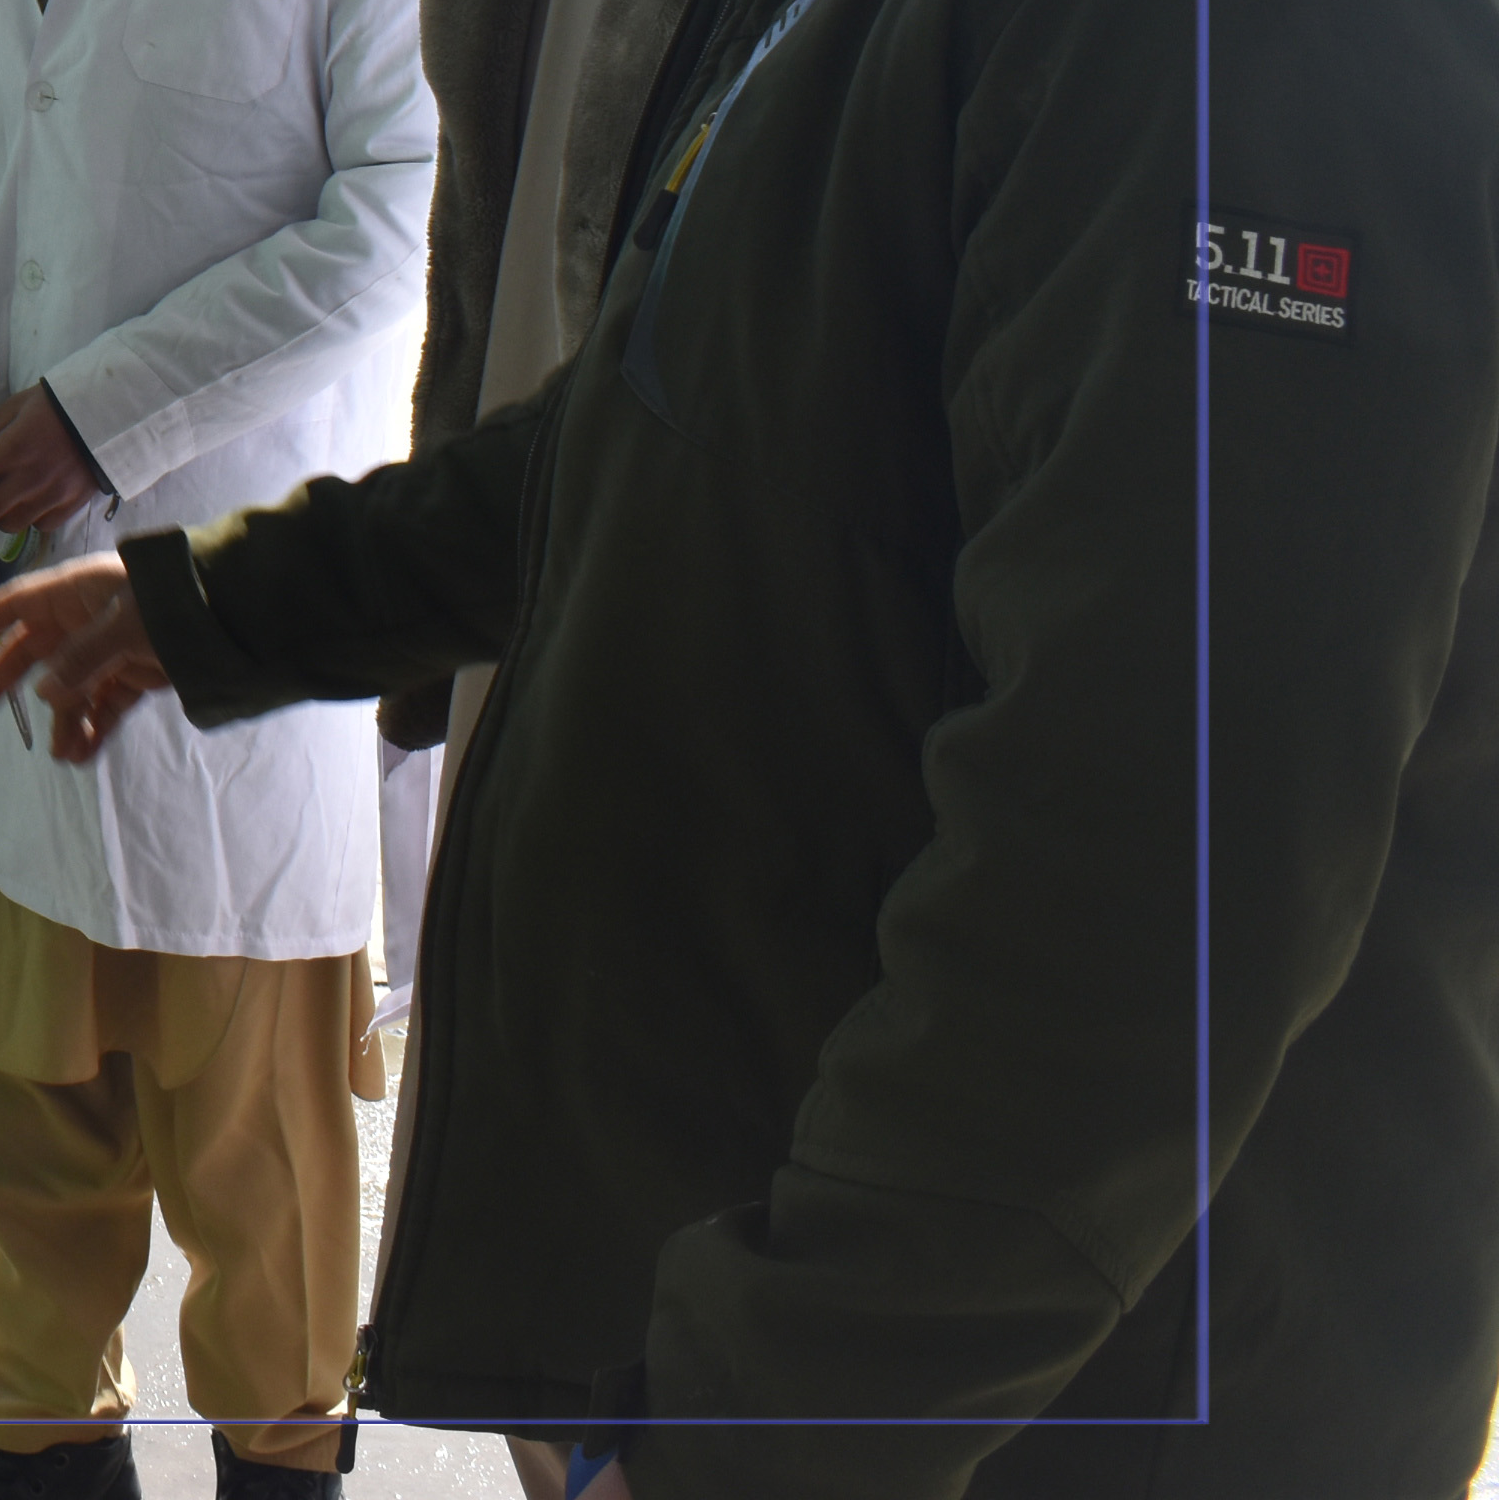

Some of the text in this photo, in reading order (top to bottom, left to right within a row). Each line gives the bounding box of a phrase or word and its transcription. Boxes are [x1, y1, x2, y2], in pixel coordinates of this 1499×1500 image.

[1195, 221, 1291, 285] 5.11
[1186, 278, 1346, 329] TACTICAL SERIES
